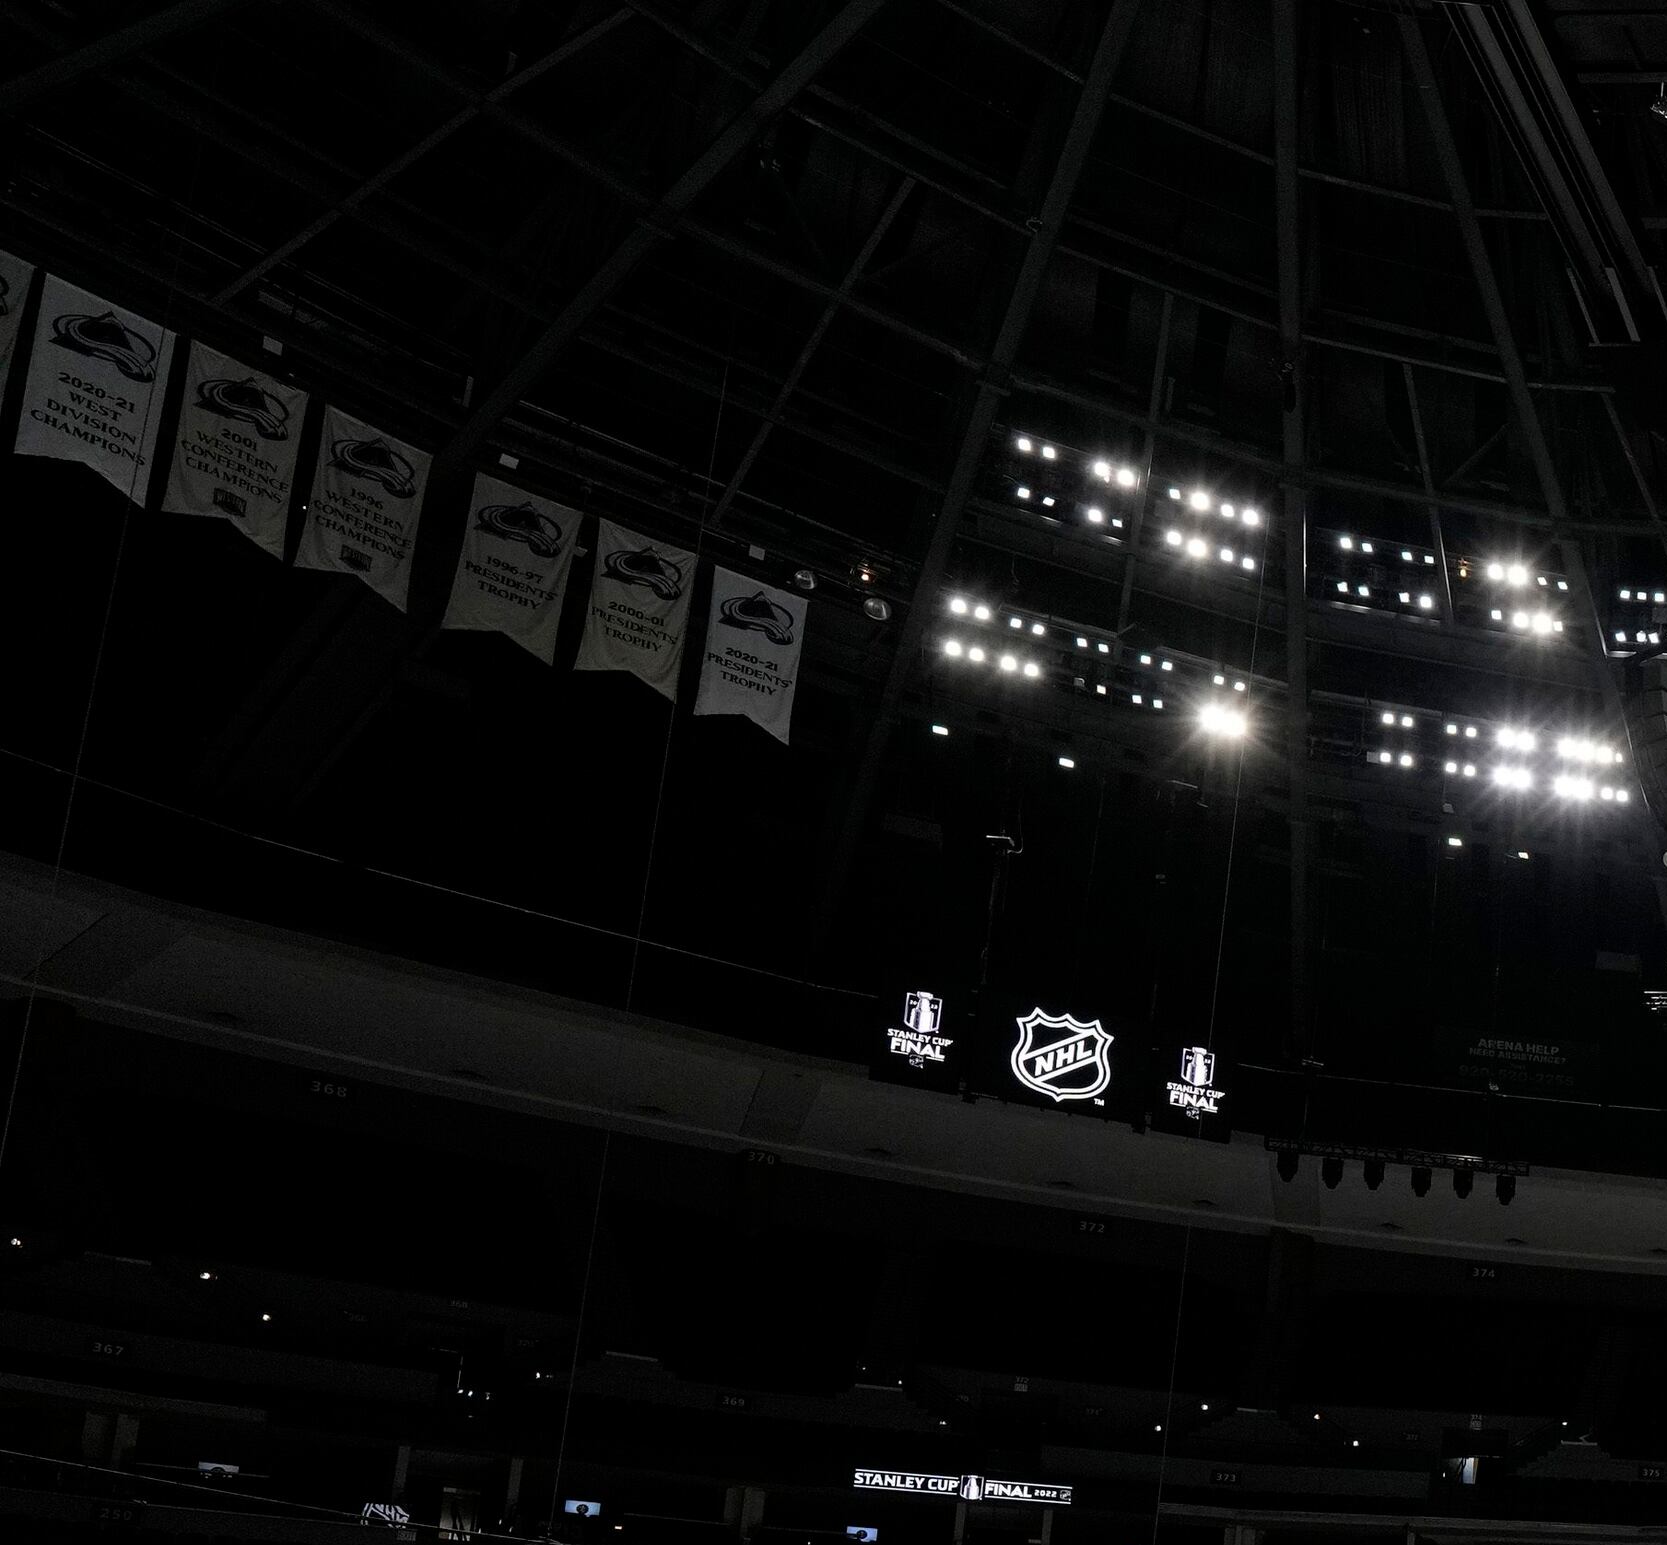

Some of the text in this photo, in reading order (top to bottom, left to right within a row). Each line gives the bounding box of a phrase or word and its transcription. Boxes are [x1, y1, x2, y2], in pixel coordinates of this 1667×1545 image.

[69, 390, 121, 422] WEST
[46, 398, 137, 445] DIVISION
[30, 409, 145, 466] CHAMPIONS
[720, 670, 776, 695] TROPHY
[887, 1028, 953, 1046] STANLEY CUP
[890, 1036, 945, 1060] FINAL
[1034, 1039, 1093, 1077] NHL
[1166, 1082, 1225, 1099] STANLEY CUP
[1170, 1090, 1218, 1111] FINAL
[1079, 1221, 1104, 1233] 372
[92, 1342, 124, 1356] 367
[853, 1472, 1057, 1498] STANLEY CUP FINAL 2022
